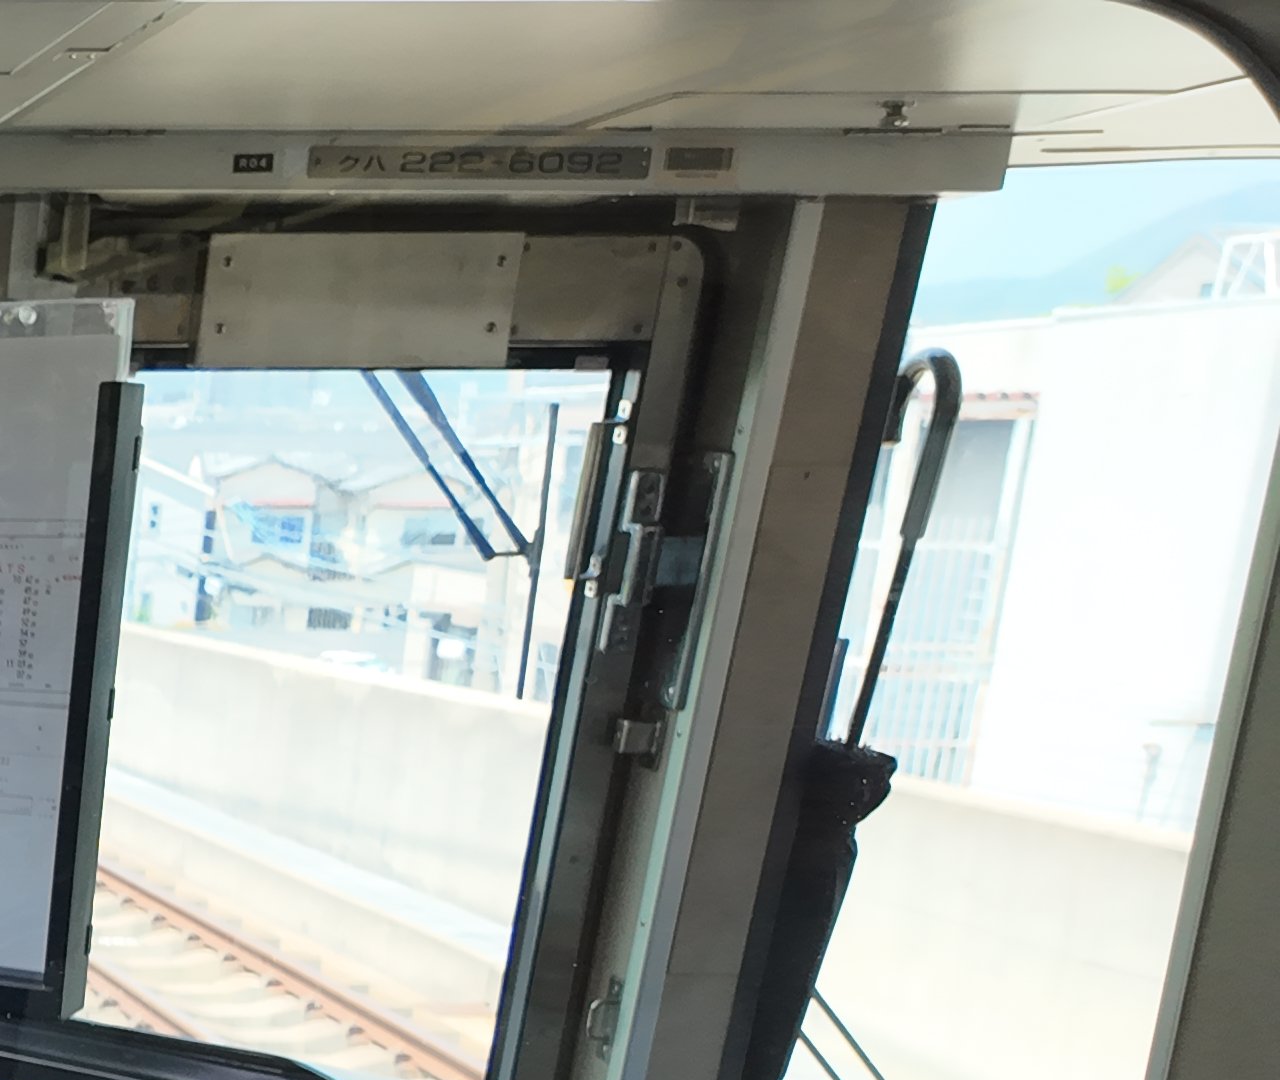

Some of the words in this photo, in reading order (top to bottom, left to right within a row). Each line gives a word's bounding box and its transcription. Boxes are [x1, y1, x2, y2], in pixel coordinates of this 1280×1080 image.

[238, 157, 268, 169] R04
[339, 154, 385, 173] クハ
[399, 151, 623, 174] 222-6092
